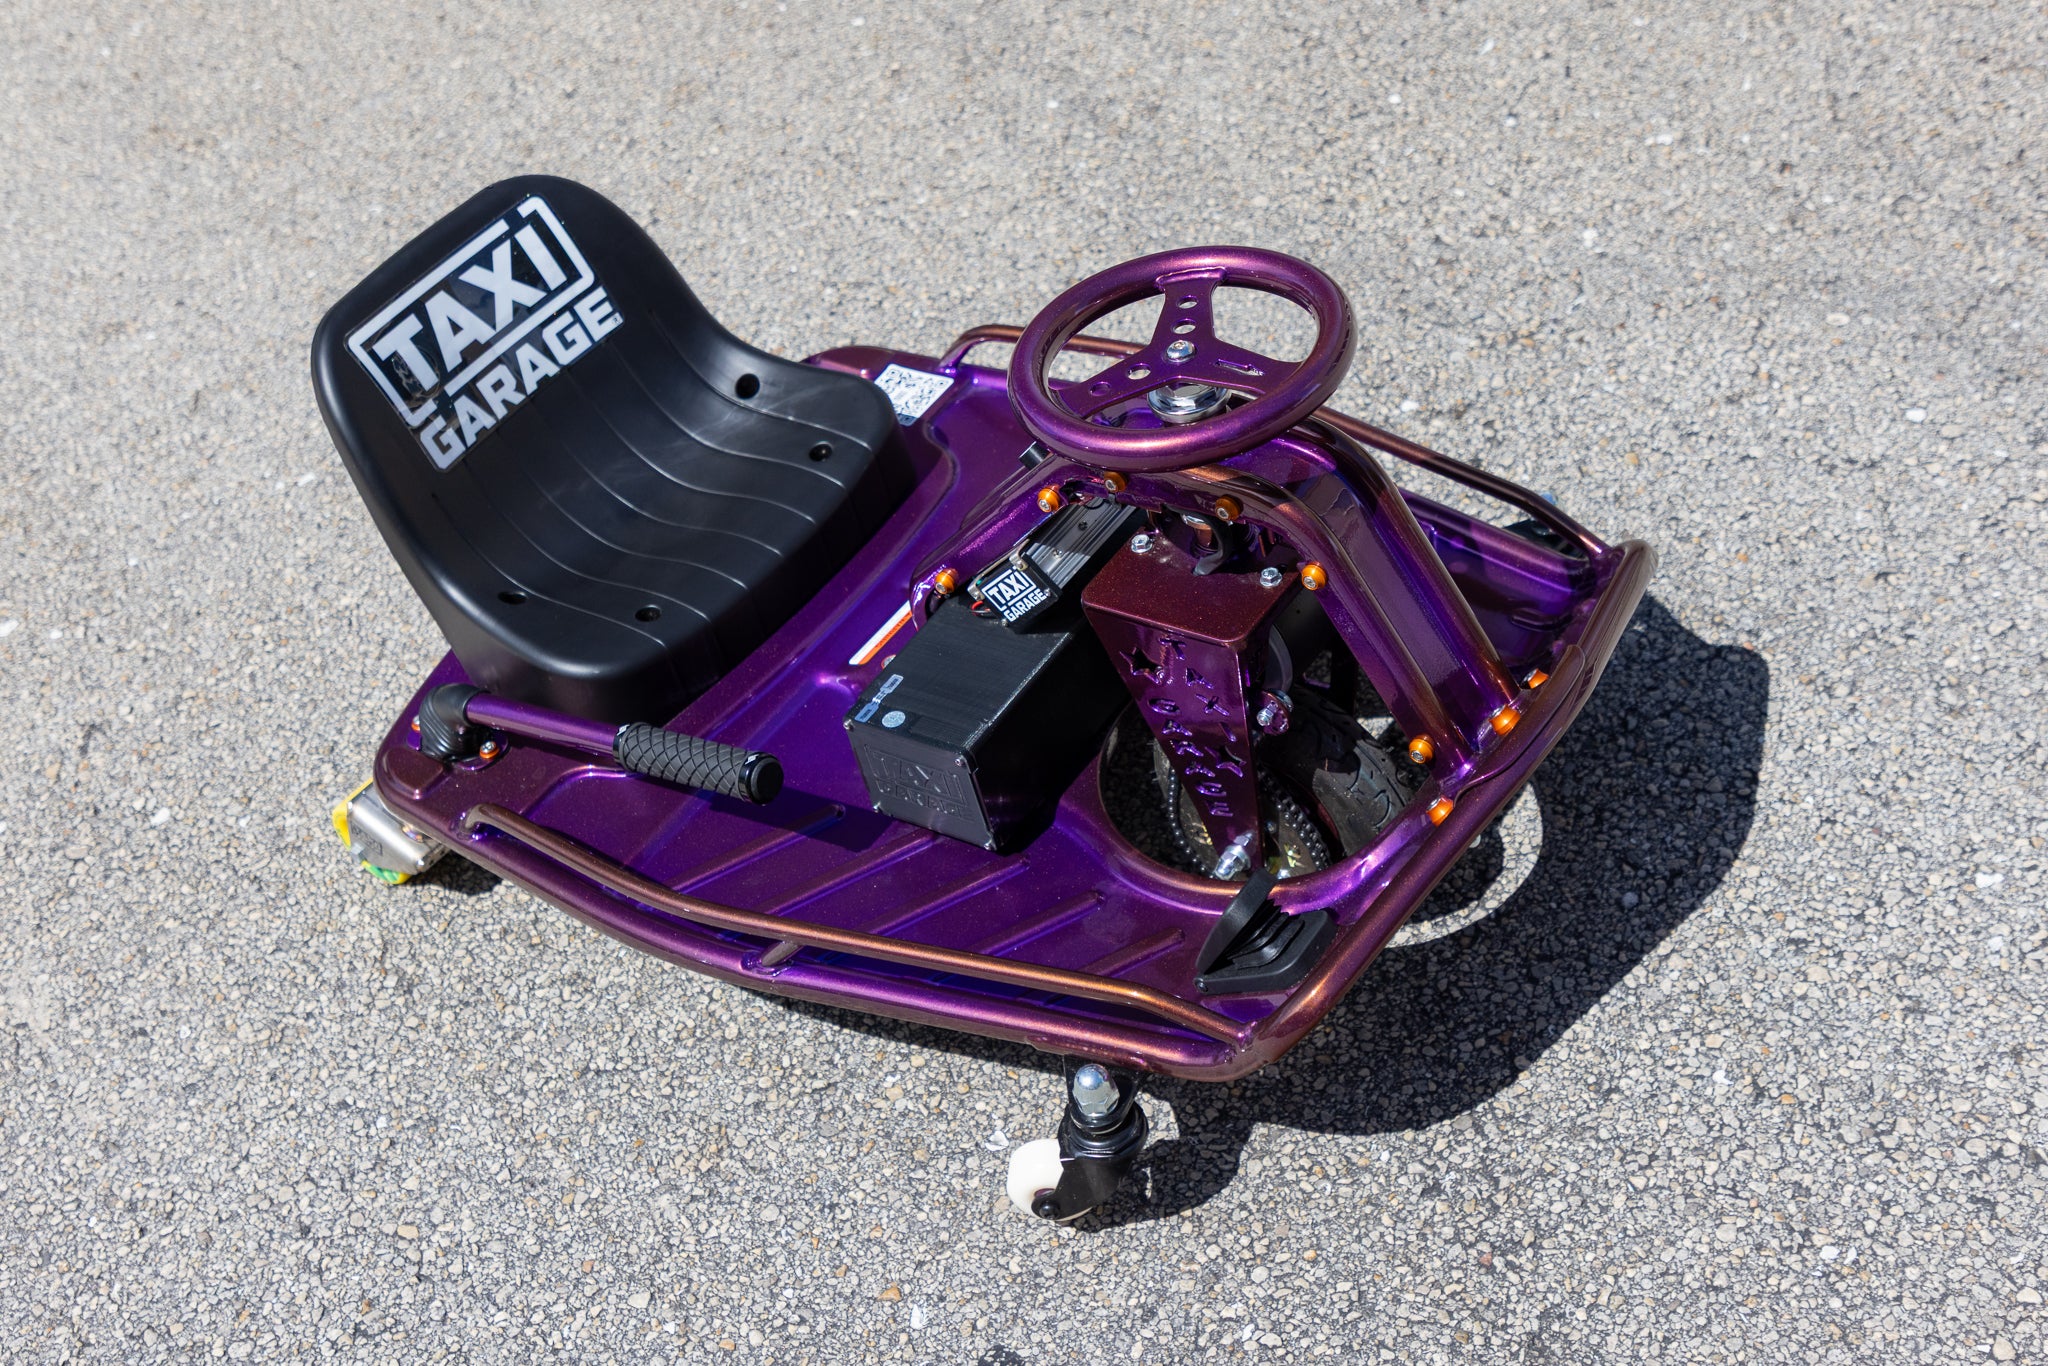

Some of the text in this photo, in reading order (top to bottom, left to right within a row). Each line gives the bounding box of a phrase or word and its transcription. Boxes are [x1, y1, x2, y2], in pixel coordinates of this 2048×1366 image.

[372, 224, 567, 390] TAXI
[420, 286, 623, 470] GARAGE
[988, 571, 1030, 604] TAXI
[1003, 588, 1047, 622] GARAGE
[1159, 638, 1237, 742] TAXI
[871, 751, 957, 801] TAXI
[1149, 699, 1233, 817] GARAGE
